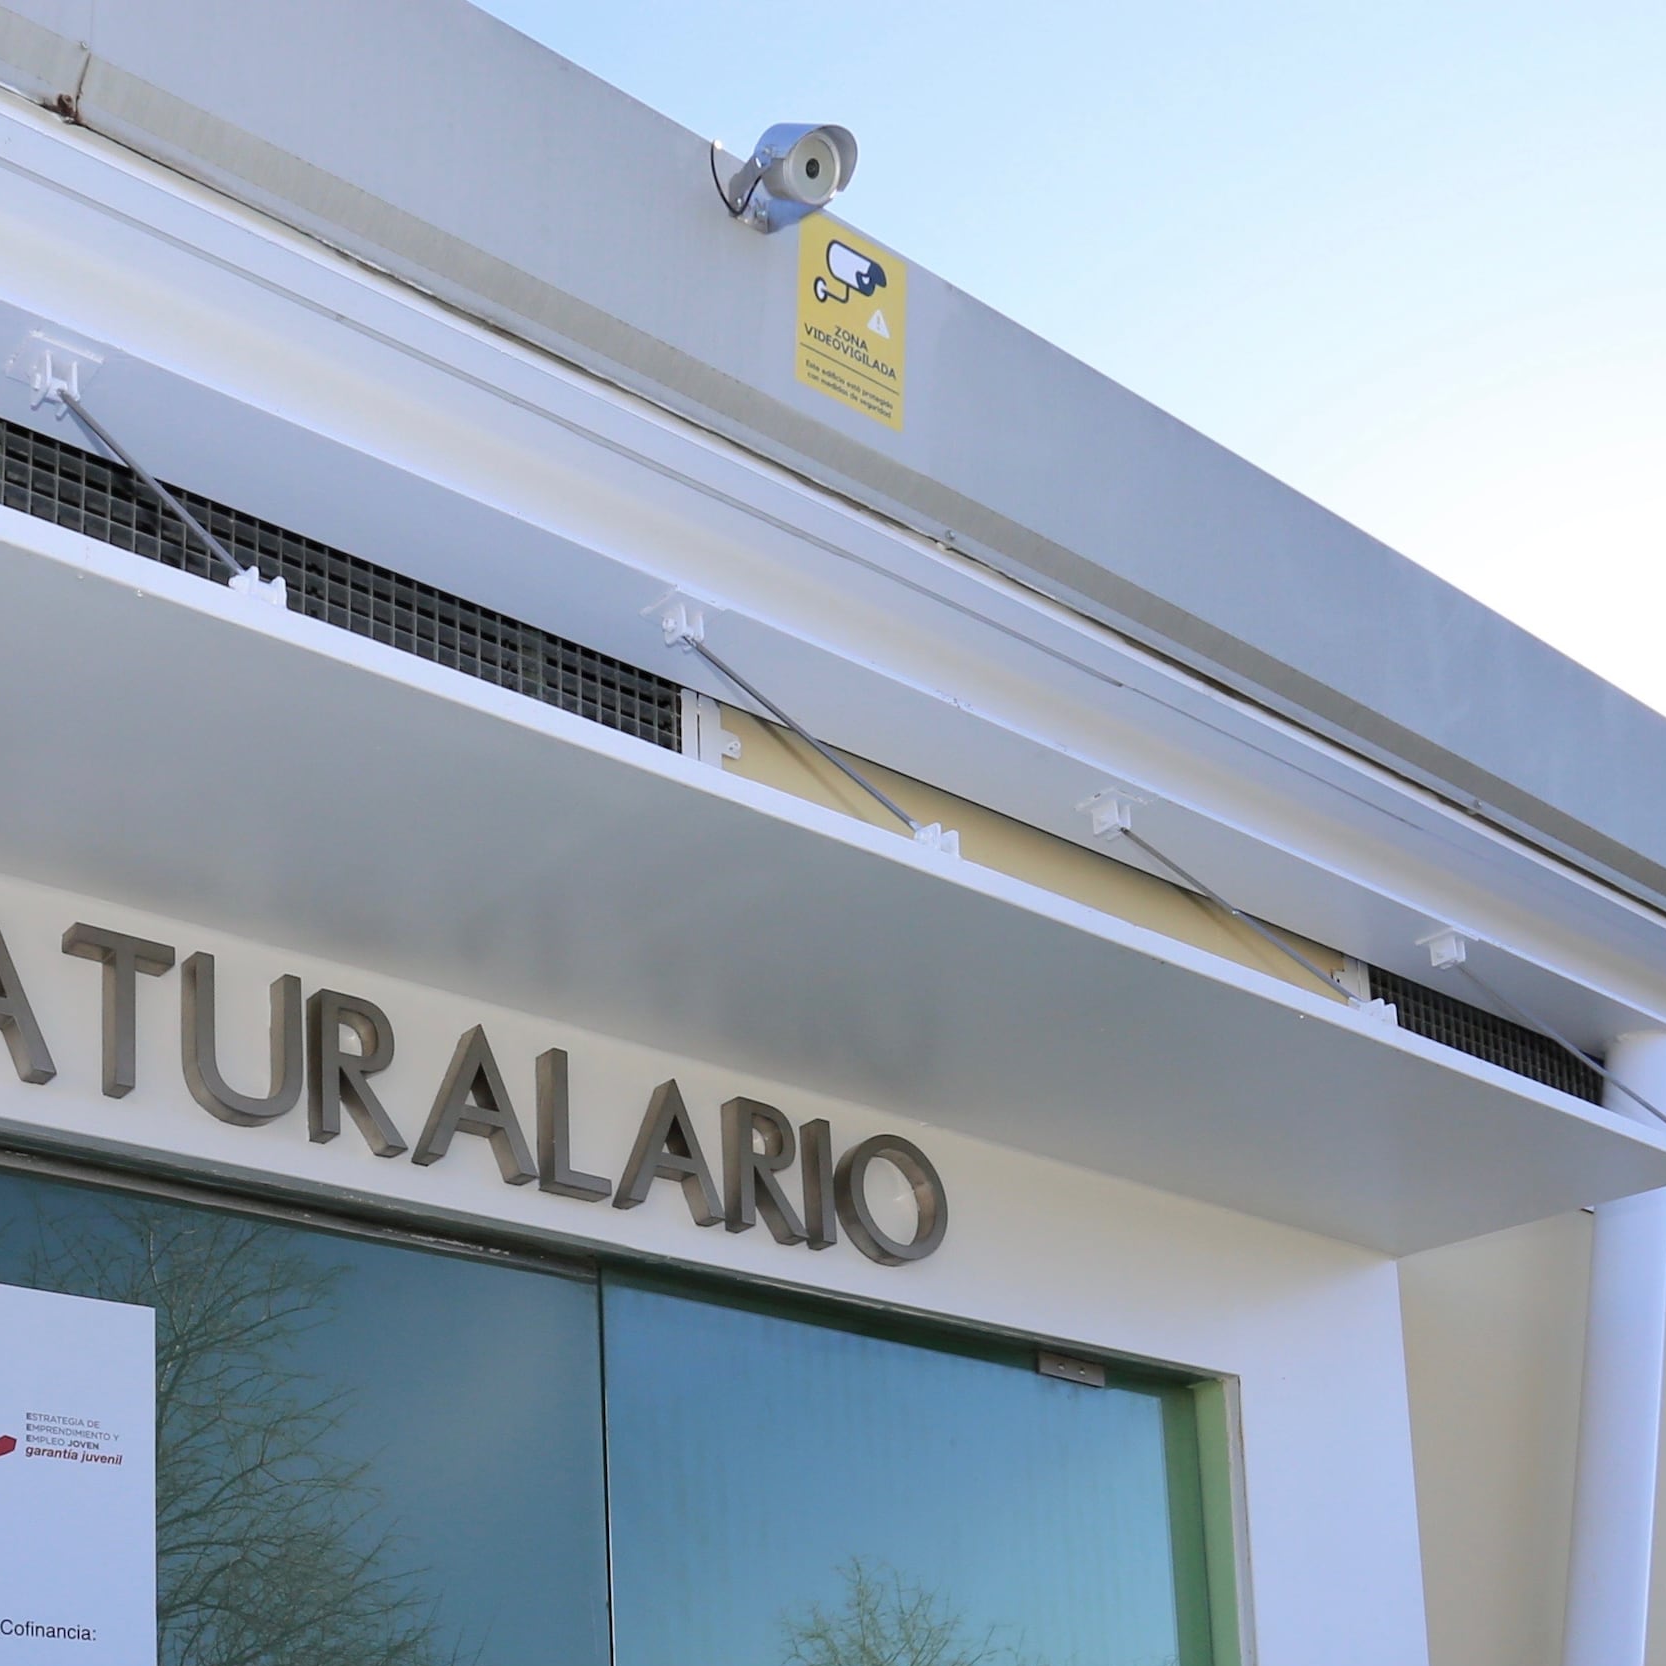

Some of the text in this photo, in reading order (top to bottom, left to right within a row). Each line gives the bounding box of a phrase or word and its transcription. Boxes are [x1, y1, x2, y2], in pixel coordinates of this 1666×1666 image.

[835, 324, 868, 352] ZONA
[804, 322, 897, 380] VIDEOVIGILADA
[805, 359, 820, 372] Este
[26, 1412, 101, 1429] ESTRATEGIA DE
[26, 1423, 120, 1441] EMPRENDIMIENTO Y
[26, 1435, 100, 1450] EMPLEO JOVEN
[25, 1446, 123, 1465] garantía juvenil
[0, 1619, 96, 1641] Cofinancia:
